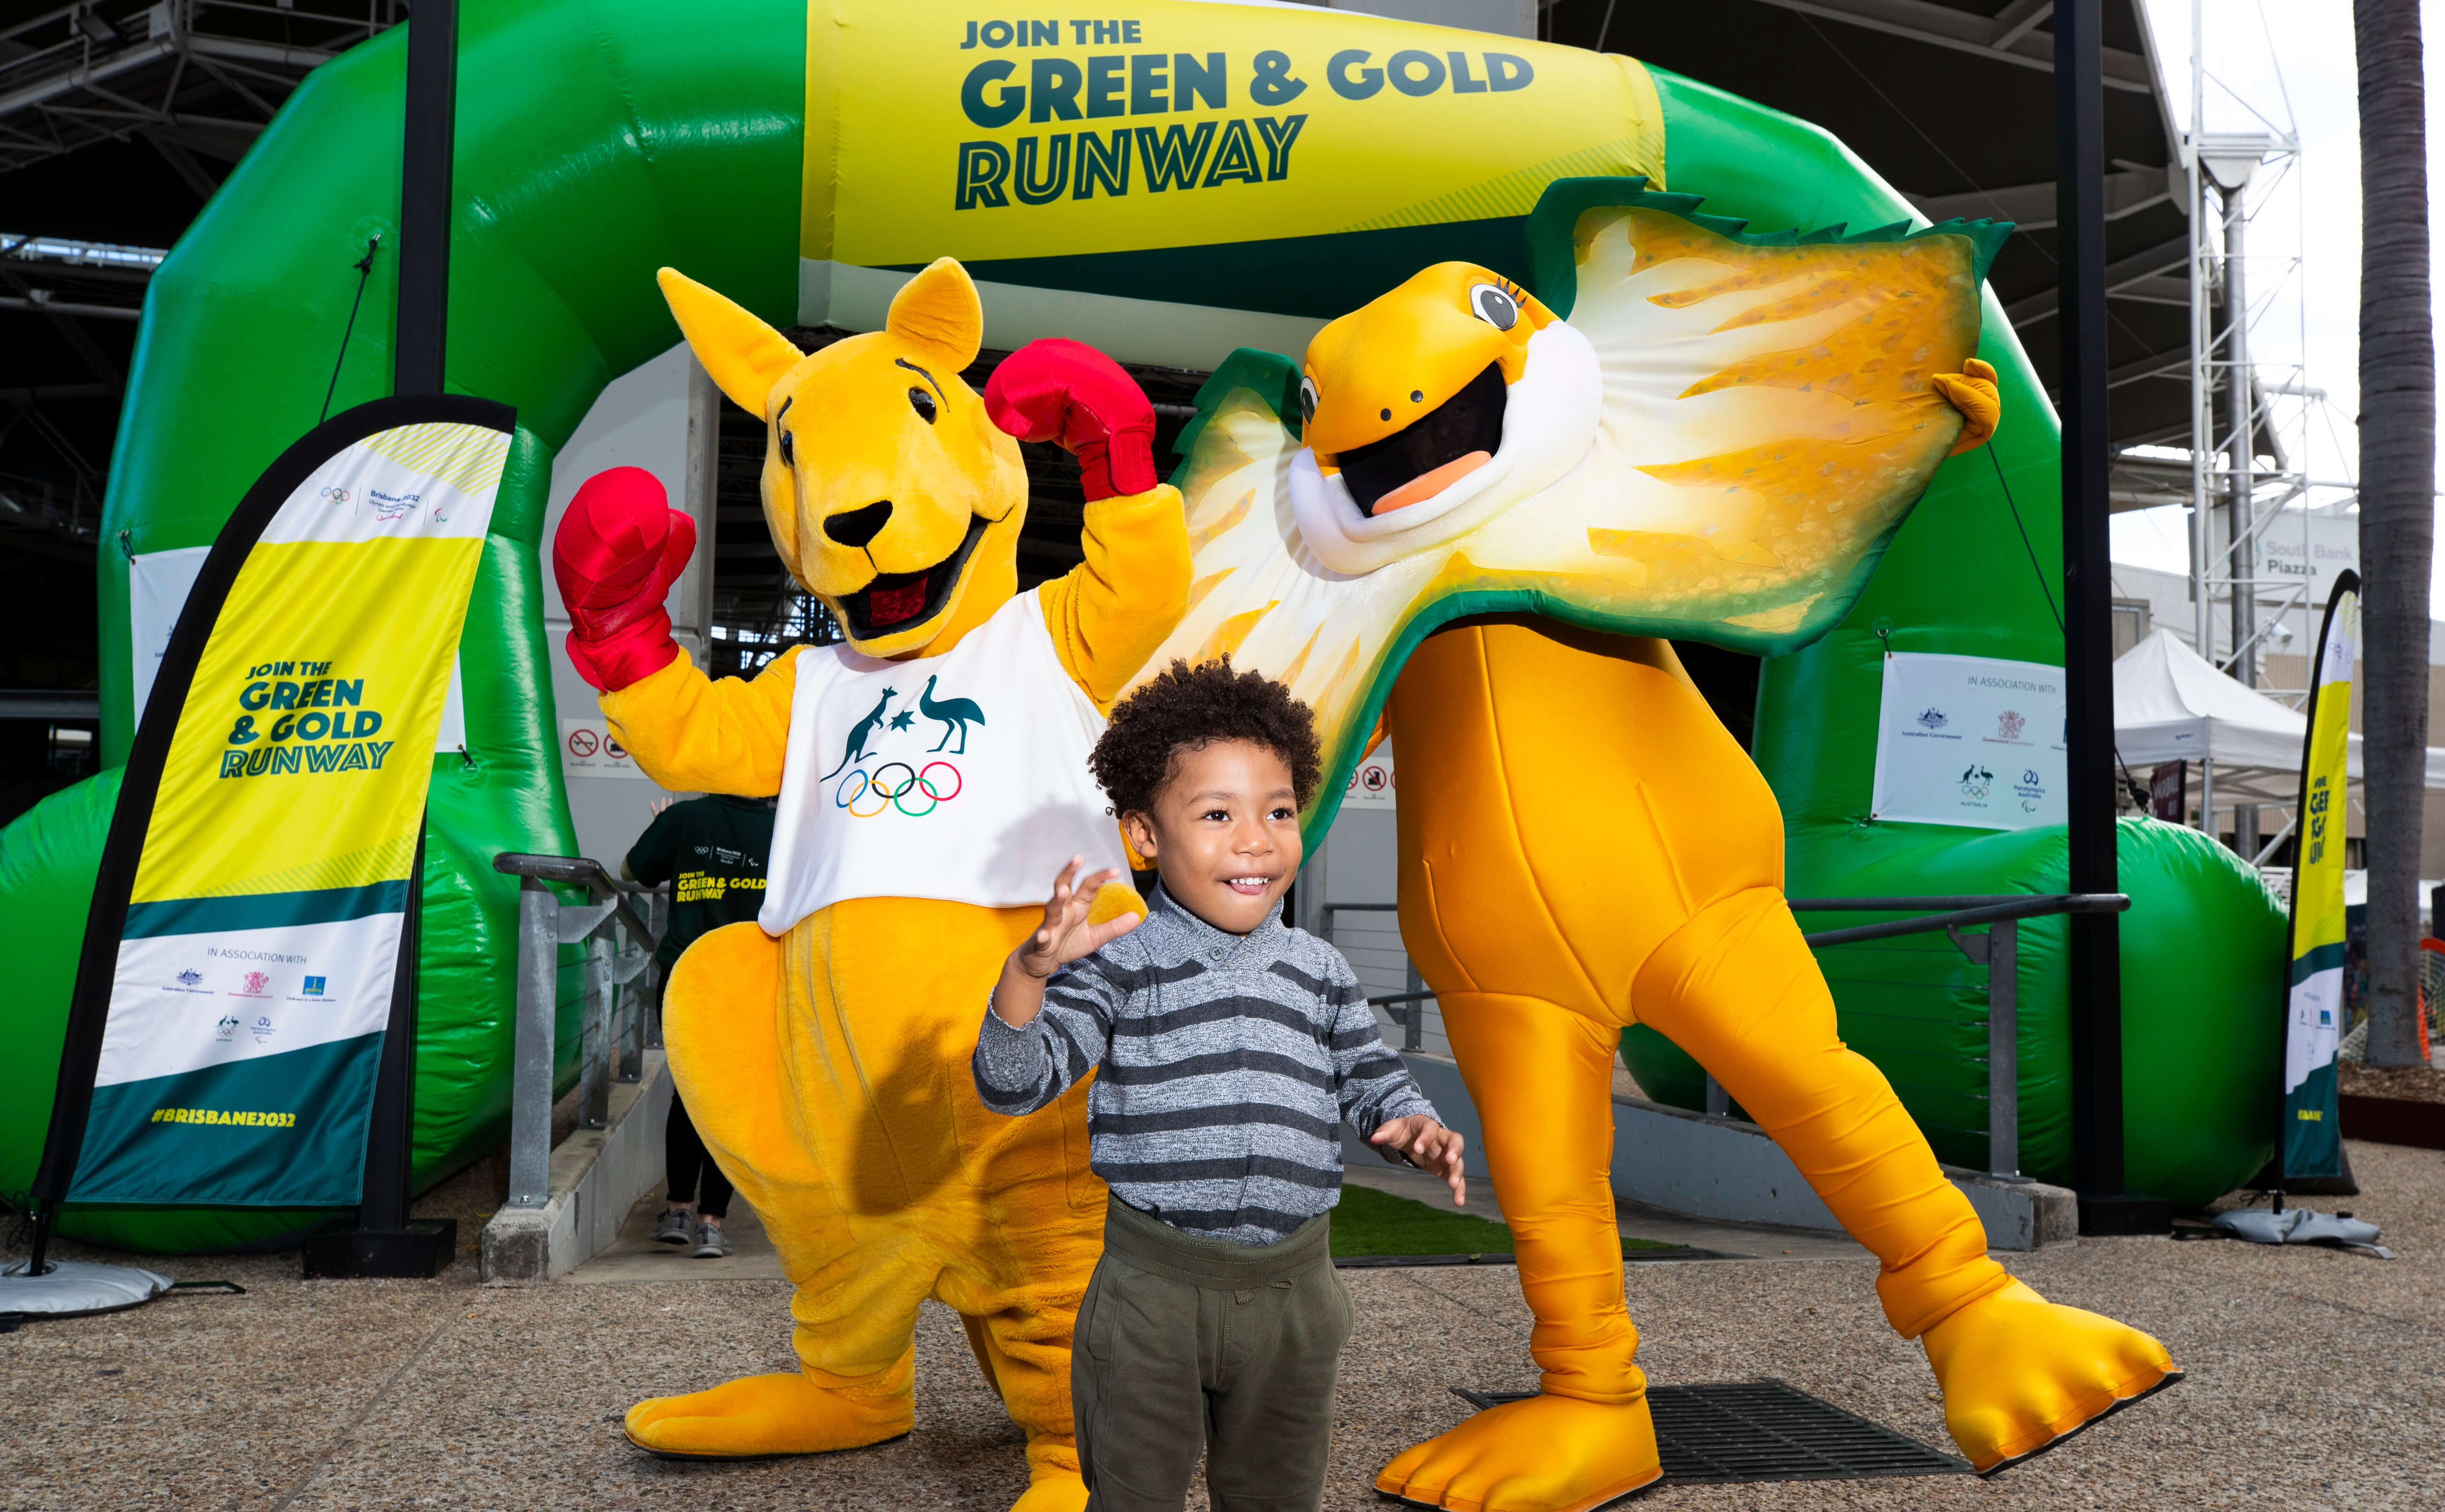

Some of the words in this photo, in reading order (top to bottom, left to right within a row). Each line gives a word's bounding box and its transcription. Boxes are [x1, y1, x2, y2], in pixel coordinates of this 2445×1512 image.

[960, 20, 1059, 49] JOIN
[1074, 19, 1142, 45] THE
[960, 52, 1227, 128] GREEN
[1249, 50, 1308, 106] &
[1326, 49, 1534, 100] GOLD
[954, 113, 1309, 211] RUNWAY
[370, 490, 401, 502] Brisbane
[2314, 544, 2353, 560] Bank
[2267, 559, 2317, 576] Piazza
[245, 661, 295, 680] JOIN
[299, 661, 332, 676] THE
[1968, 676, 1977, 686] IN
[1980, 677, 2036, 692] ASSOCIATION
[2038, 684, 2056, 694] WITH
[239, 679, 364, 711] GREEN
[228, 715, 260, 745] &
[270, 711, 382, 742] GOLD
[219, 741, 395, 778] RUNWAY
[2013, 785, 2046, 794] Paralympics
[678, 877, 715, 891] GREEN
[716, 877, 727, 888] &
[730, 877, 766, 890] GOLD
[677, 888, 725, 902] RUNWAY
[207, 948, 217, 957] IN
[220, 949, 284, 963] ASSOCIATION
[286, 955, 307, 965] WITH
[151, 1108, 296, 1127] #BRISBANE2032
